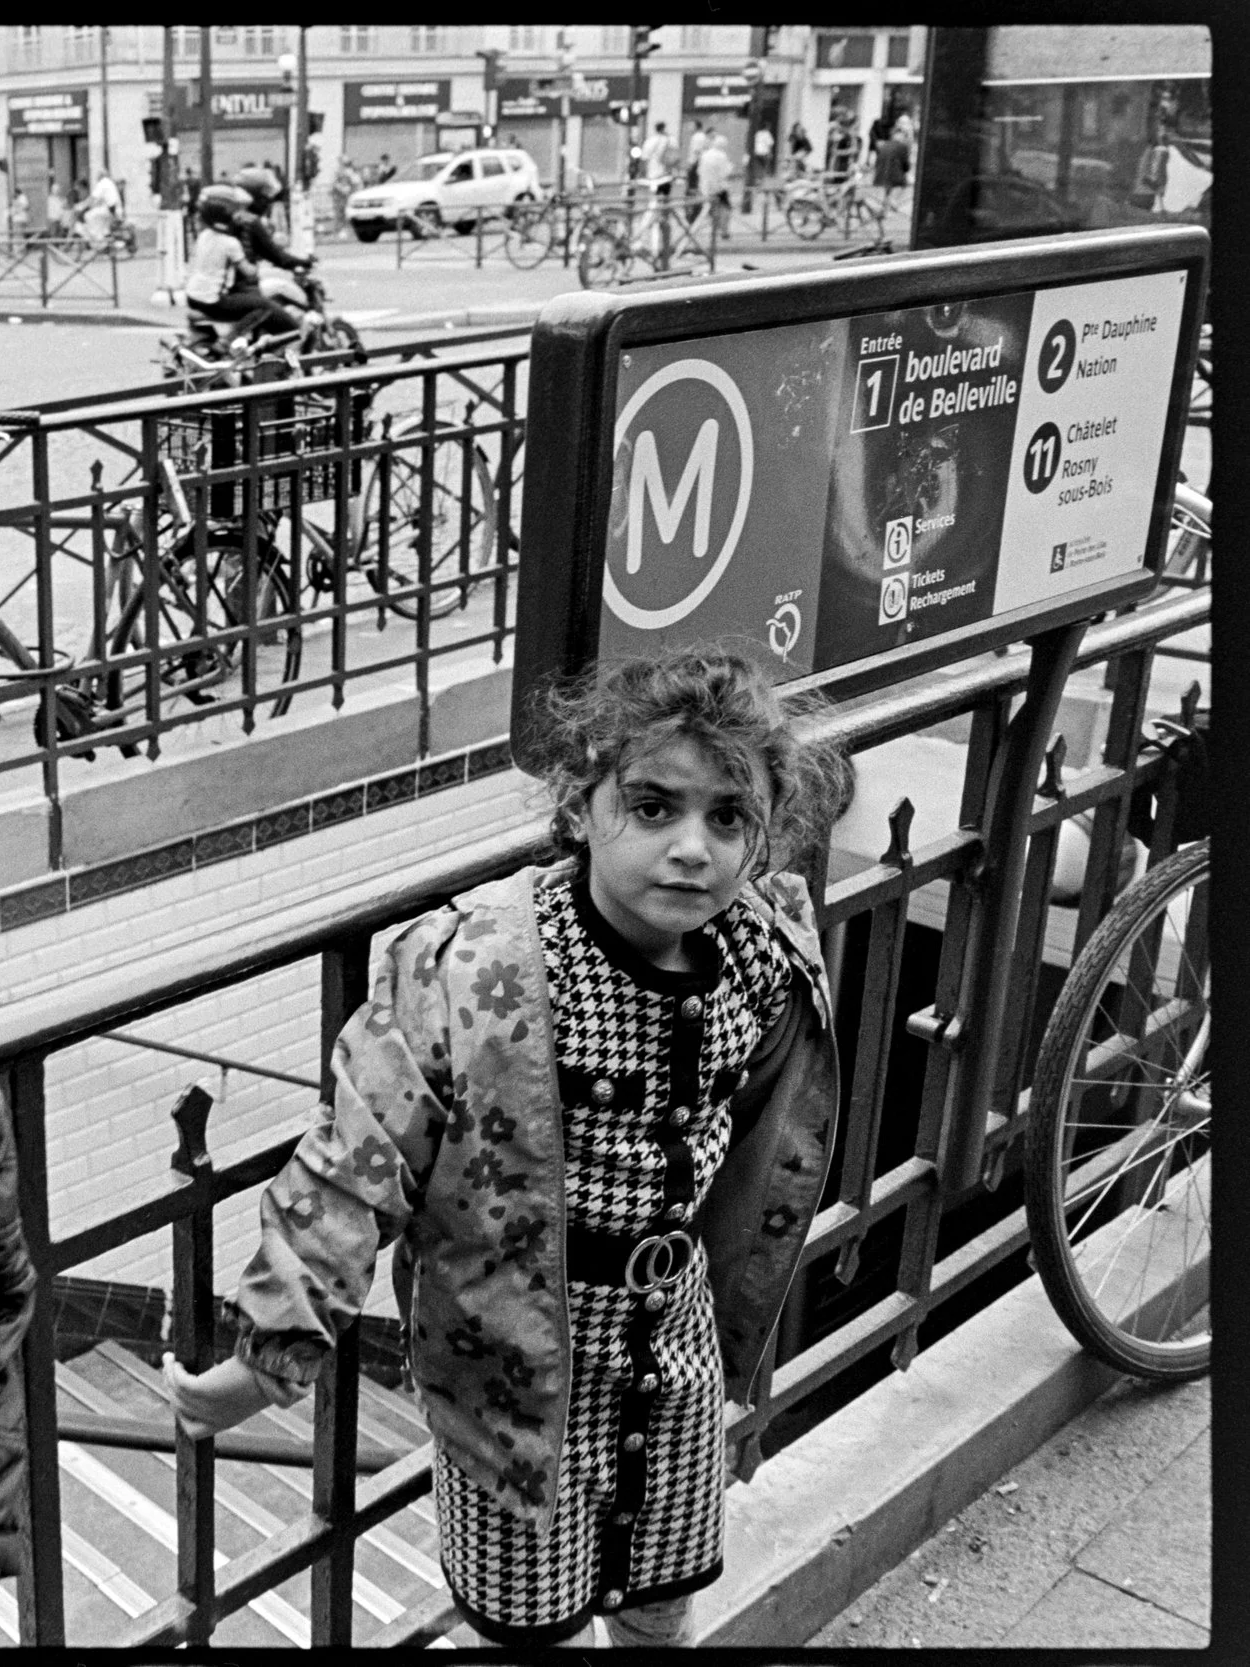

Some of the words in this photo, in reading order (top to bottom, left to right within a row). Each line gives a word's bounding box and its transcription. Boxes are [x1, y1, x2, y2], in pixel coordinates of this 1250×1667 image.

[1101, 313, 1157, 340] Dauphine
[860, 333, 903, 354] Entrée
[1046, 334, 1067, 379] 2
[905, 335, 1003, 383] boulevard
[1076, 356, 1117, 379] Nation
[866, 370, 883, 417] 1
[899, 391, 925, 424] de
[928, 374, 1017, 418] Belleville
[1067, 416, 1118, 444] Châtelet
[1029, 435, 1056, 481] 11
[1061, 456, 1099, 479] Rosny
[626, 418, 720, 575] M
[1057, 475, 1114, 507] sous-Bois
[915, 513, 956, 534] Services
[911, 569, 946, 588] Tickets
[774, 589, 803, 605] RATP
[910, 580, 976, 611] Rechargement
